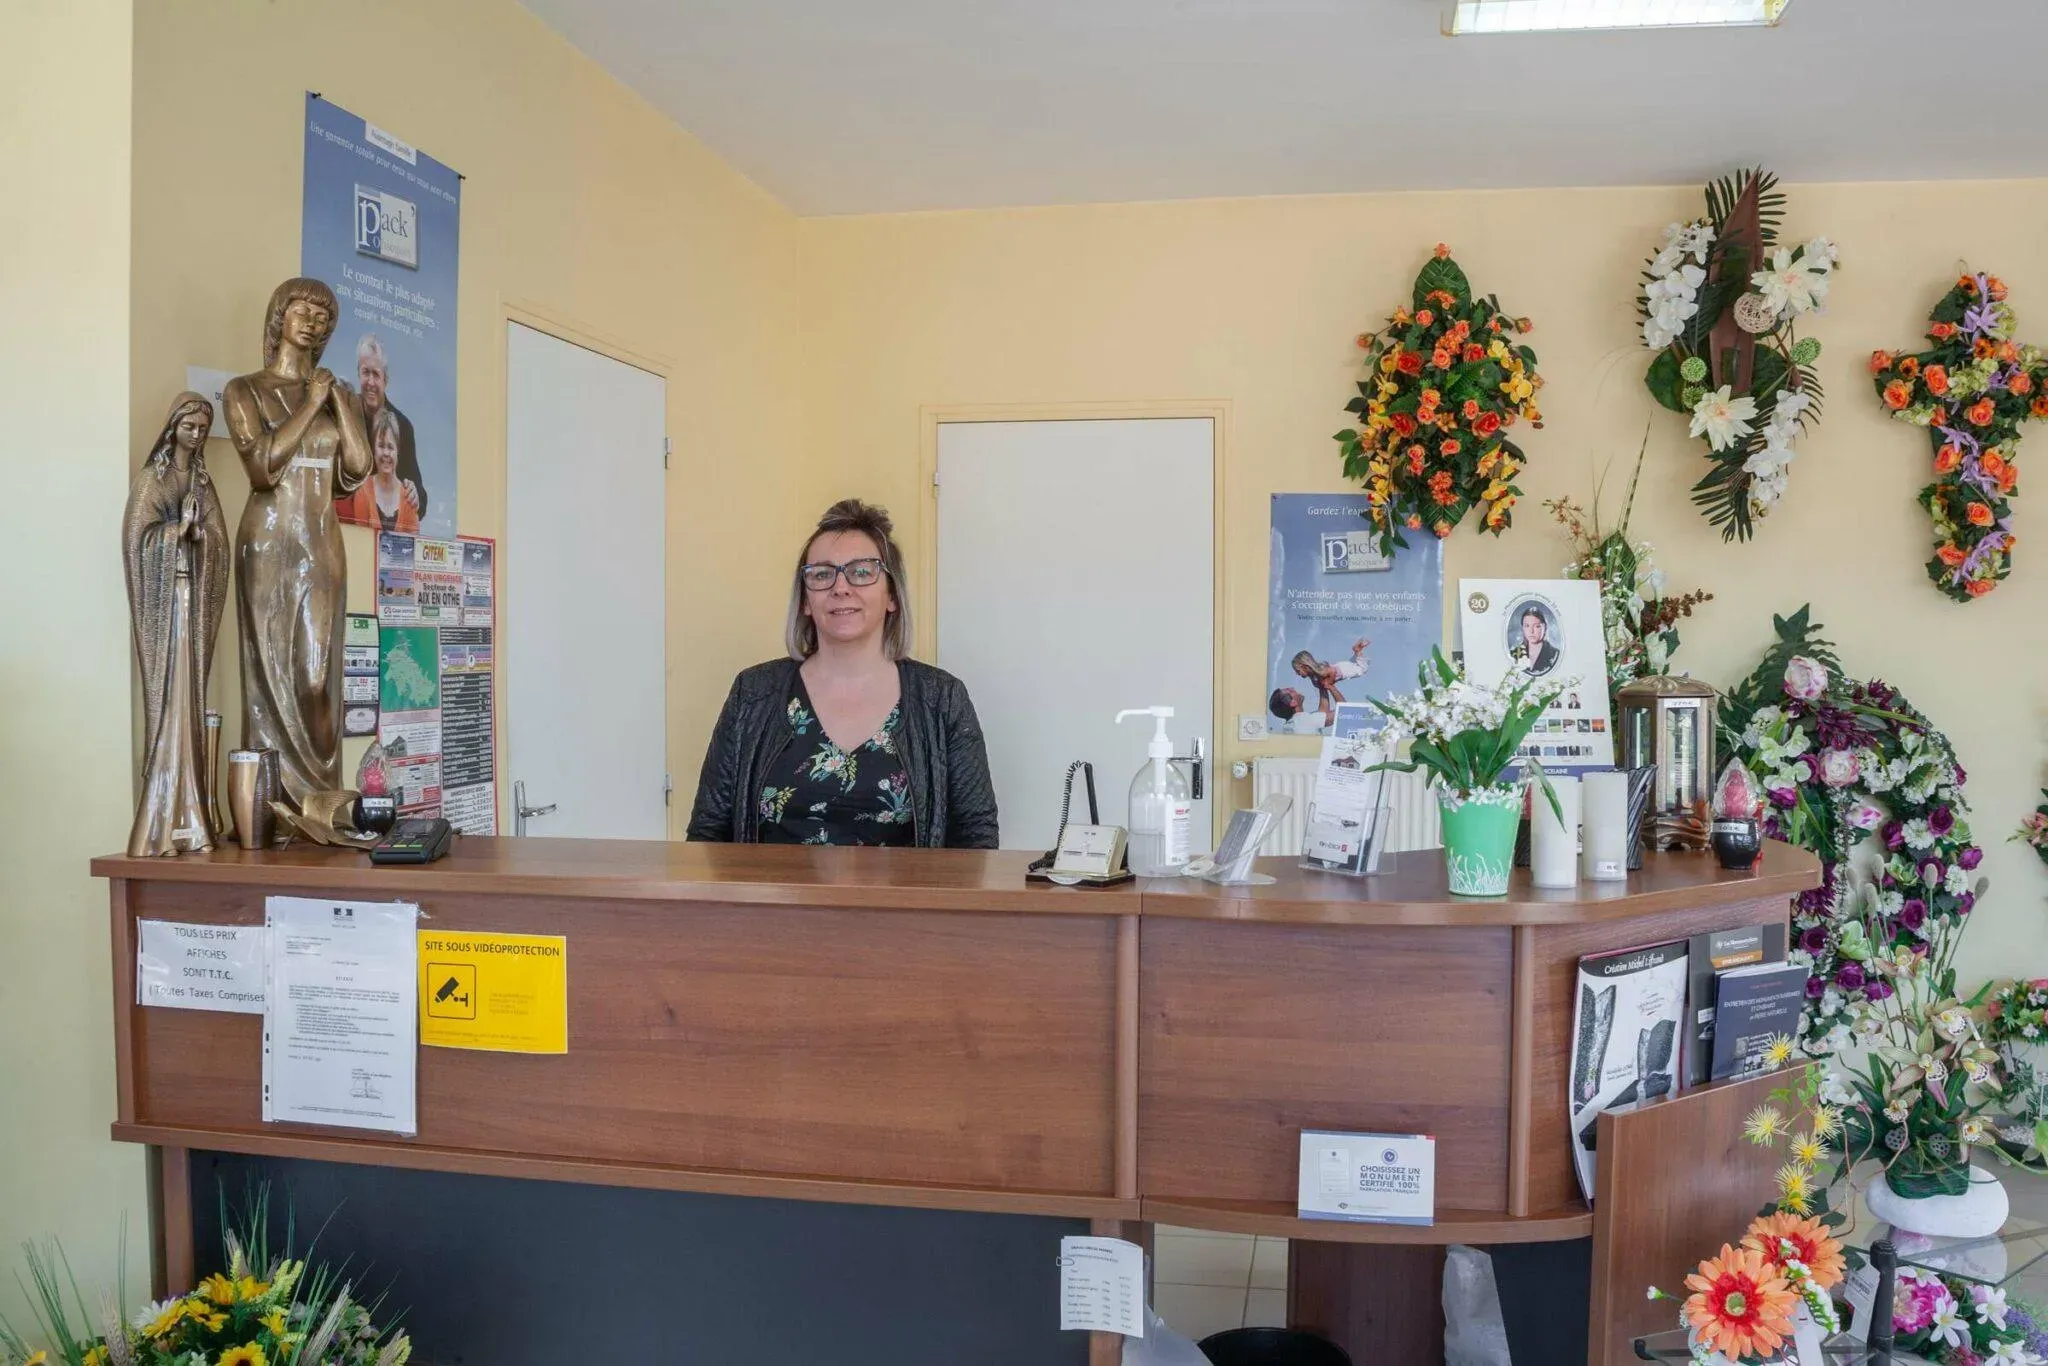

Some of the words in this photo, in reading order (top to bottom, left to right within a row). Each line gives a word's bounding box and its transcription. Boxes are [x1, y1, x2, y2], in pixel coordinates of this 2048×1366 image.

[343, 262, 354, 279] Le
[355, 271, 384, 290] contrat
[1307, 506, 1340, 516] Gardez
[1342, 506, 1362, 518] l'esp
[423, 545, 444, 561] GITEM
[415, 572, 432, 582] PLAN
[434, 574, 463, 584] URGENCE
[422, 583, 447, 591] Secteur
[417, 592, 430, 605] AIX
[431, 592, 441, 606] EN
[442, 593, 460, 606] OTHE
[1287, 588, 1334, 599] N'attendez
[1337, 590, 1353, 601] pas
[1355, 591, 1372, 601] que
[1375, 592, 1390, 600] vos
[1392, 590, 1426, 601] enfants
[1291, 600, 1338, 612] s'occupent
[1341, 601, 1351, 609] de
[1355, 602, 1370, 610] vos
[1471, 598, 1486, 609] 20
[174, 927, 199, 938] TOUS
[216, 930, 237, 940] PRIX
[425, 940, 444, 951] SITE
[445, 941, 471, 952] SOUS
[182, 967, 207, 977] SONT
[208, 969, 234, 980] T.T.C.
[189, 987, 214, 998] Taxes
[218, 989, 265, 1003] Comprises
[1360, 1165, 1406, 1174] CHOISISSEZ
[1360, 1172, 1421, 1182] MONUMENT
[1397, 1181, 1420, 1189] 100%
